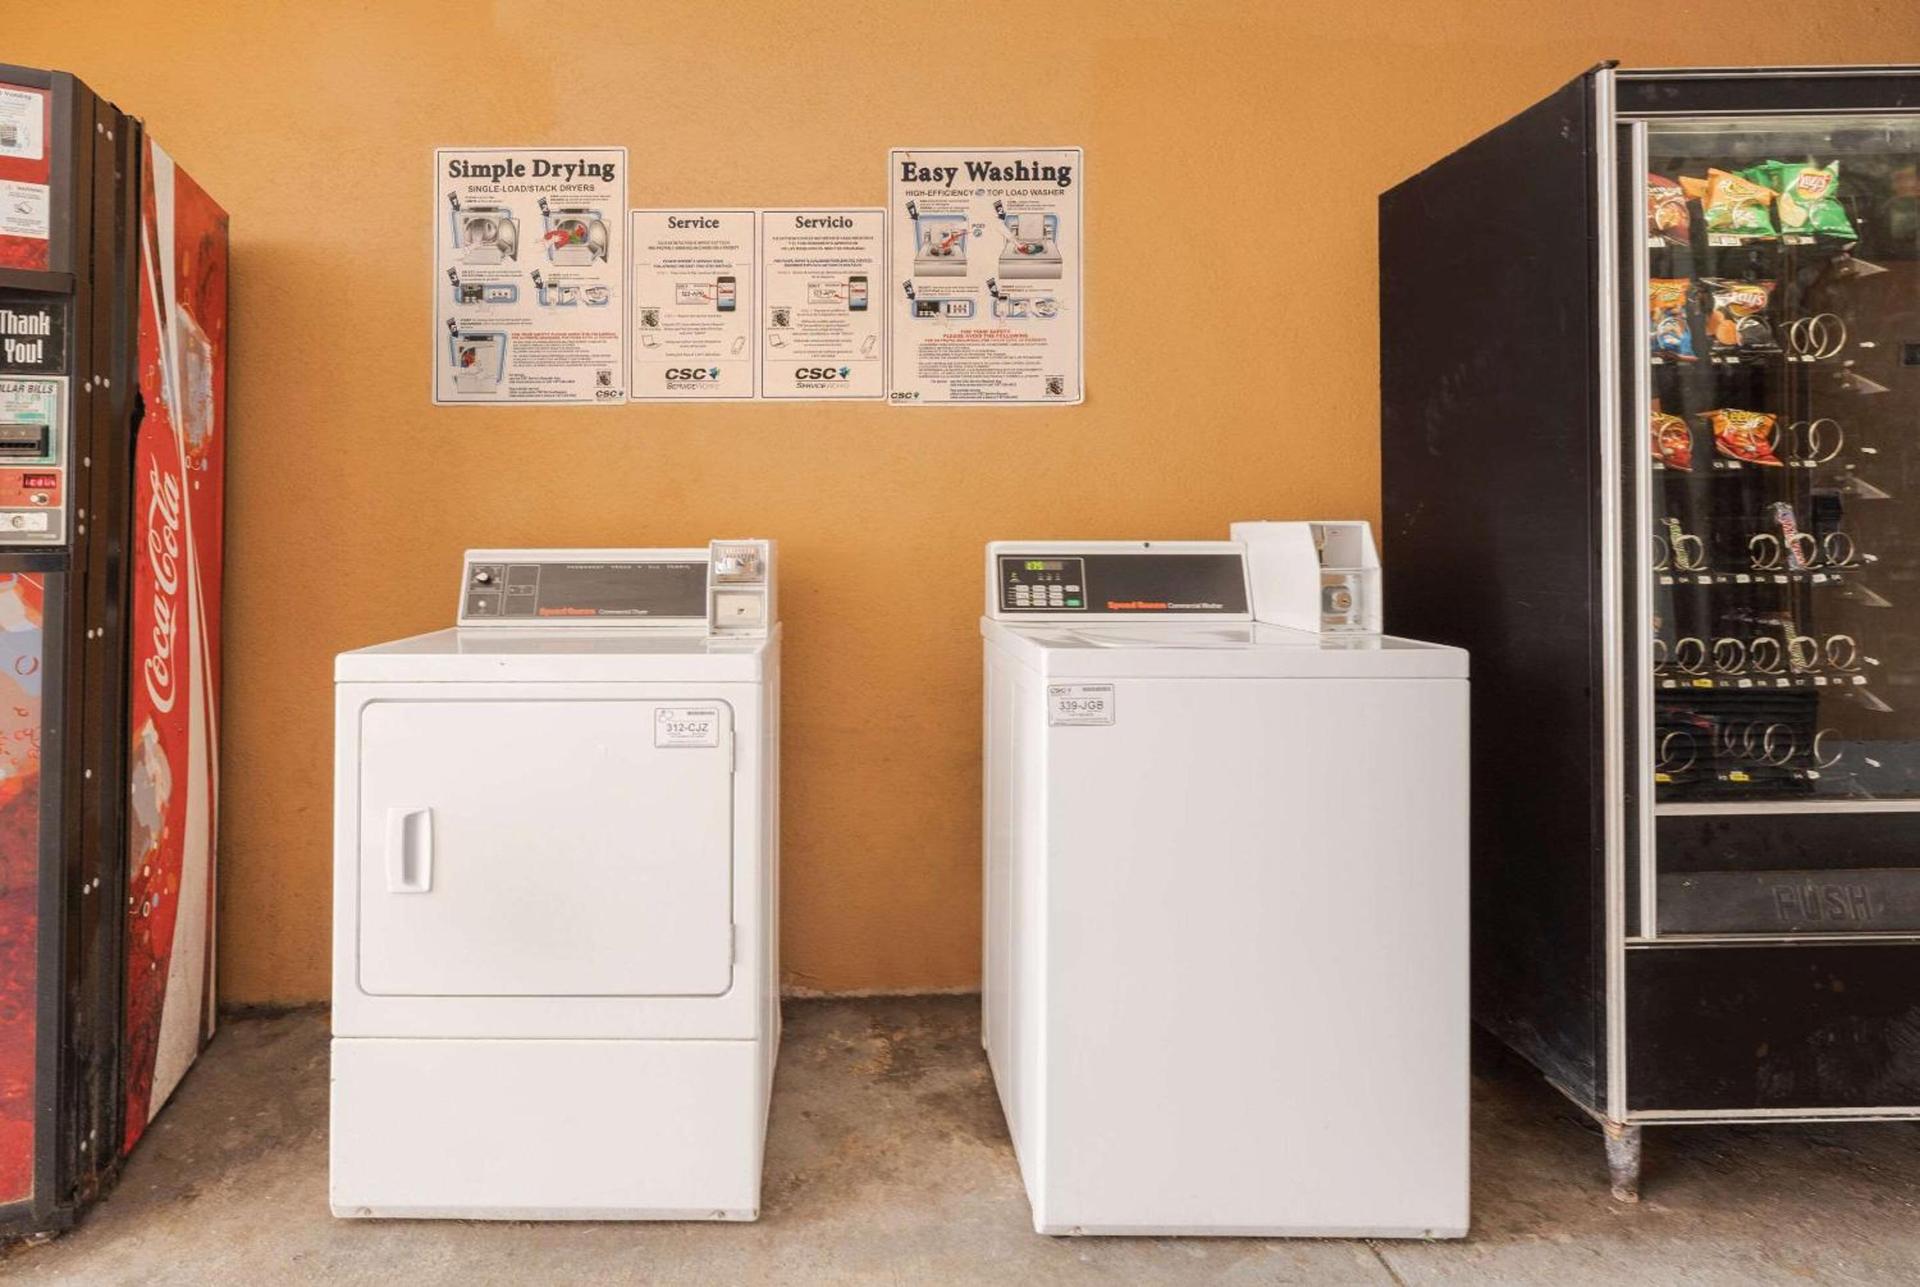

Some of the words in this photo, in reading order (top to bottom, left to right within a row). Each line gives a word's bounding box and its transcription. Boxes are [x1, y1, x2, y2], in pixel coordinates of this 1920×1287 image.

[449, 158, 525, 183] Simple
[532, 159, 615, 182] Drying
[901, 161, 958, 188] Easy
[965, 160, 1072, 187] Washing
[559, 184, 595, 192] DRYERS
[905, 189, 974, 197] HIGH-EFFICIENCY
[667, 216, 720, 229] Service
[795, 216, 853, 229] Servicio
[0, 310, 50, 335] Thank
[5, 339, 43, 363] You!
[665, 368, 707, 380] CSC
[794, 368, 837, 380] CSC
[0, 384, 25, 393] LLAR
[28, 384, 54, 393] BILLS
[595, 390, 617, 398] CSC
[144, 453, 180, 713] Coca-Cola
[1059, 700, 1104, 710] 339-JGB
[666, 722, 709, 732] 312-CJZ
[1773, 884, 1872, 921] PUSH
